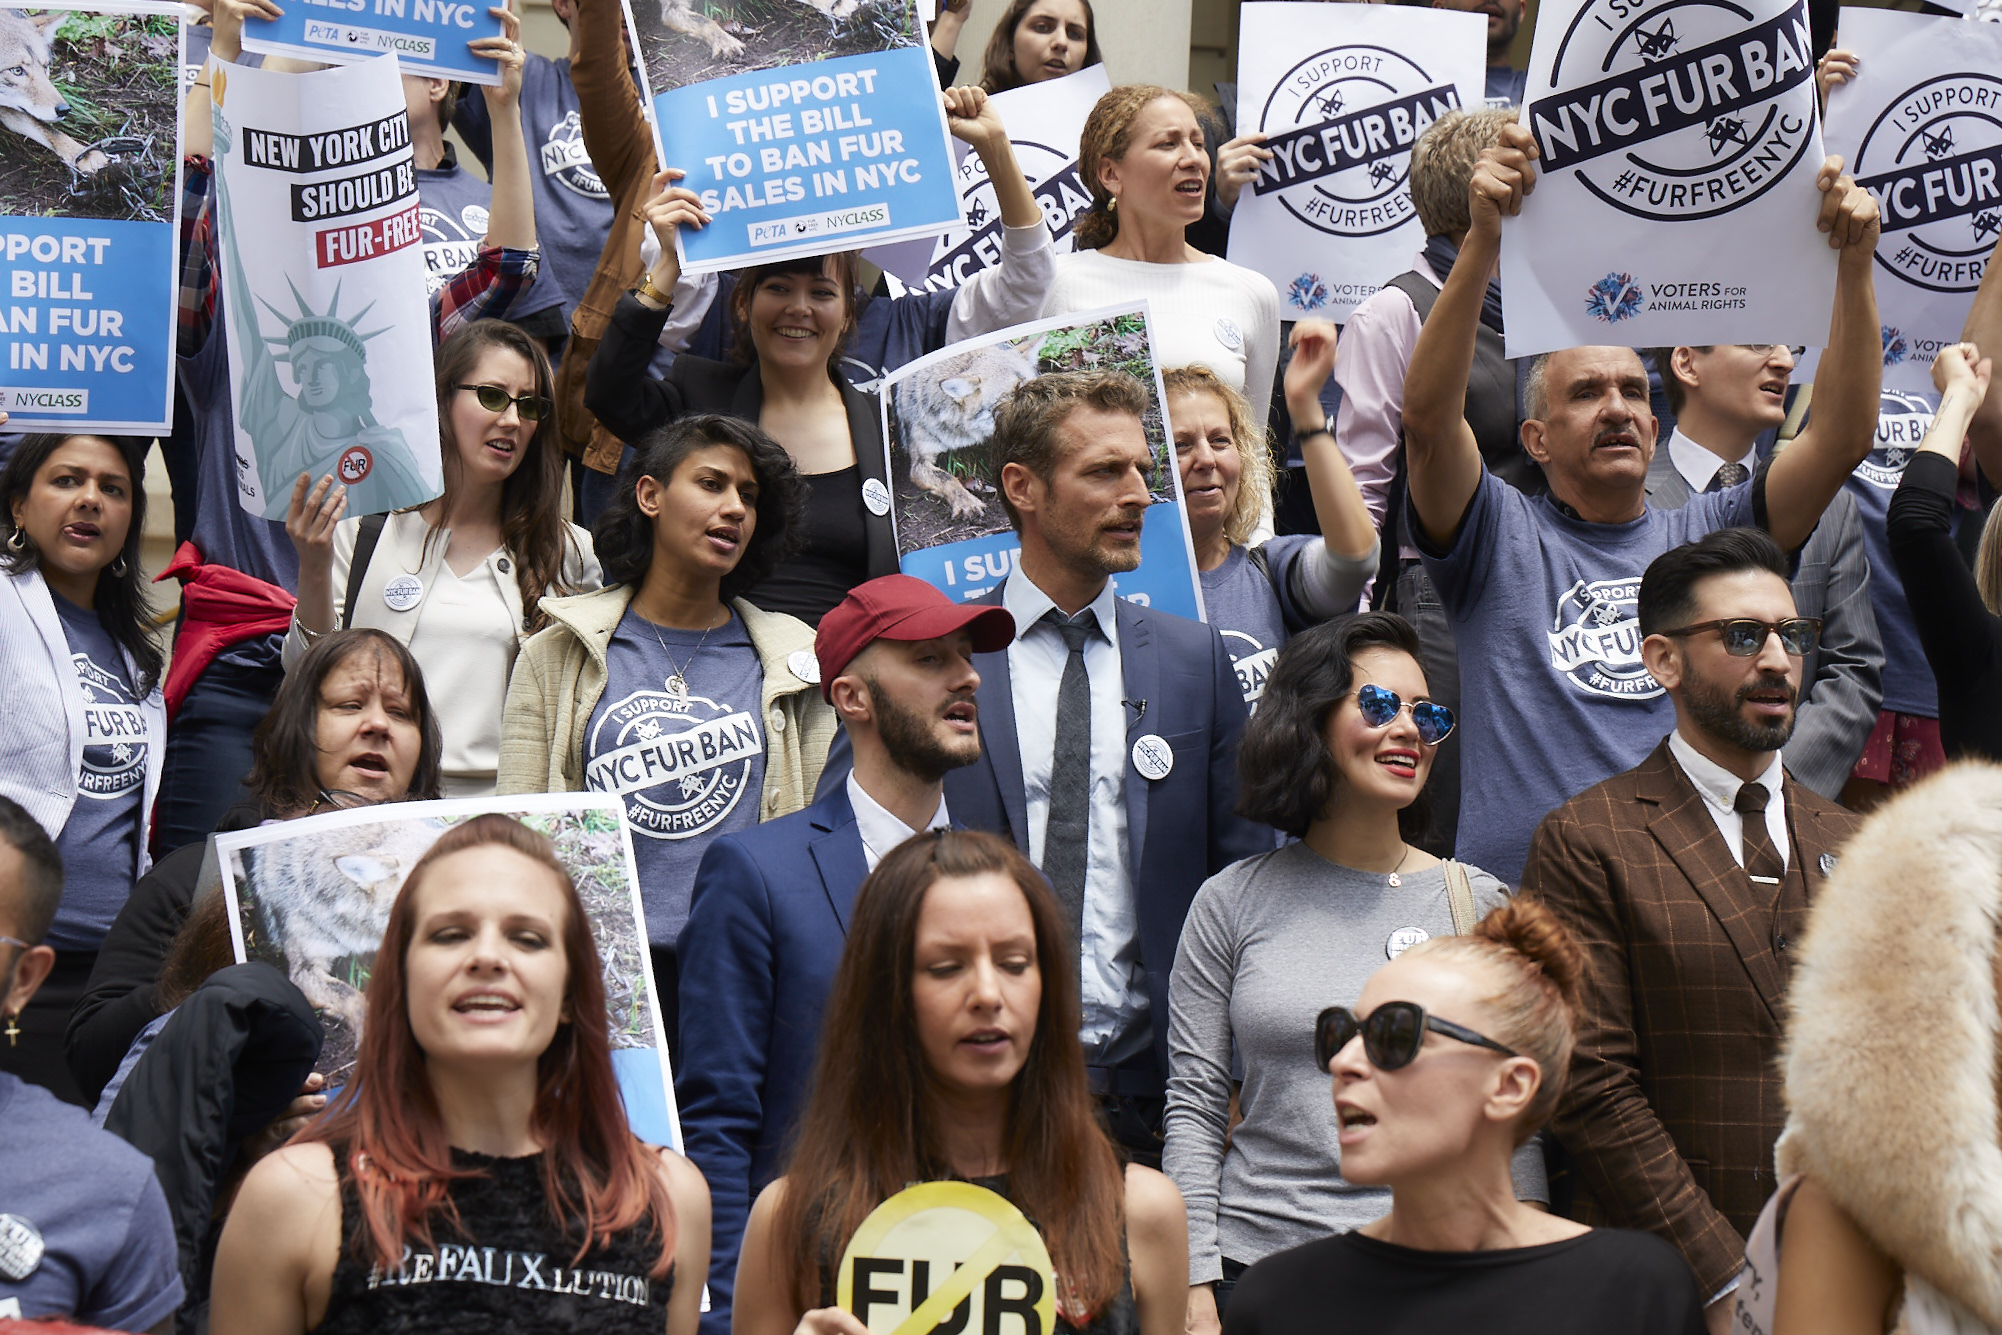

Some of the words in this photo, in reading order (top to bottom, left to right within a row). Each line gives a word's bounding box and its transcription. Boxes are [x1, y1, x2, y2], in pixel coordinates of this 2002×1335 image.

[413, 0, 476, 28] NYC
[1594, 15, 1613, 31] I
[377, 35, 430, 53] NYCLASS
[1288, 88, 1301, 98] I
[1297, 55, 1383, 89] SUPPORT
[1535, 87, 1640, 162] NYC
[1638, 53, 1740, 128] FUR
[1740, 12, 1813, 93] BAN
[706, 95, 719, 118] I
[725, 68, 878, 115] SUPPORT
[726, 113, 795, 145] THE
[801, 103, 873, 135] BILL
[1893, 119, 1906, 132] I
[1904, 86, 2002, 123] SUPPORT
[250, 132, 300, 169] NEW
[309, 125, 375, 167] YORK
[378, 112, 409, 153] CITY
[705, 152, 753, 181] TO
[759, 139, 832, 174] BAN
[839, 129, 906, 161] FUR
[1256, 134, 1323, 188] NYC
[1320, 114, 1391, 167] FUR
[544, 145, 582, 169] NYC
[1612, 113, 1803, 208] #FURFREENYC
[301, 170, 393, 218] SHOULD
[396, 160, 415, 195] BE
[700, 176, 805, 215] SALES
[812, 169, 848, 198] IN
[854, 158, 922, 191] NYC
[1866, 177, 1922, 225] YC
[1923, 157, 2001, 214] FUR
[826, 208, 884, 229] NYCLASS
[0, 234, 111, 265] PORT
[325, 207, 420, 263] FUR-FREE
[11, 270, 93, 300] BILL
[1650, 283, 1721, 298] VOTERS
[1724, 287, 1747, 296] FOR
[1648, 300, 1698, 312] ANIMAL
[1701, 299, 1746, 310] RIGHTS
[49, 307, 124, 337] FUR
[10, 342, 48, 370] IN
[60, 344, 135, 373] NYC
[1914, 339, 1952, 351] VOT
[15, 392, 82, 408] NYCLASS
[344, 458, 366, 472] FUR
[944, 561, 956, 586] I
[1573, 598, 1583, 609] I
[1551, 631, 1599, 663] NYC
[85, 710, 129, 737] FUR
[612, 714, 624, 724] I
[620, 699, 693, 719] SUPPORT
[588, 755, 640, 792] NYC
[640, 740, 698, 778] FUR
[698, 719, 757, 761] BAN
[628, 774, 737, 831] #FURFREENYC
[852, 1257, 1043, 1335] FUR
